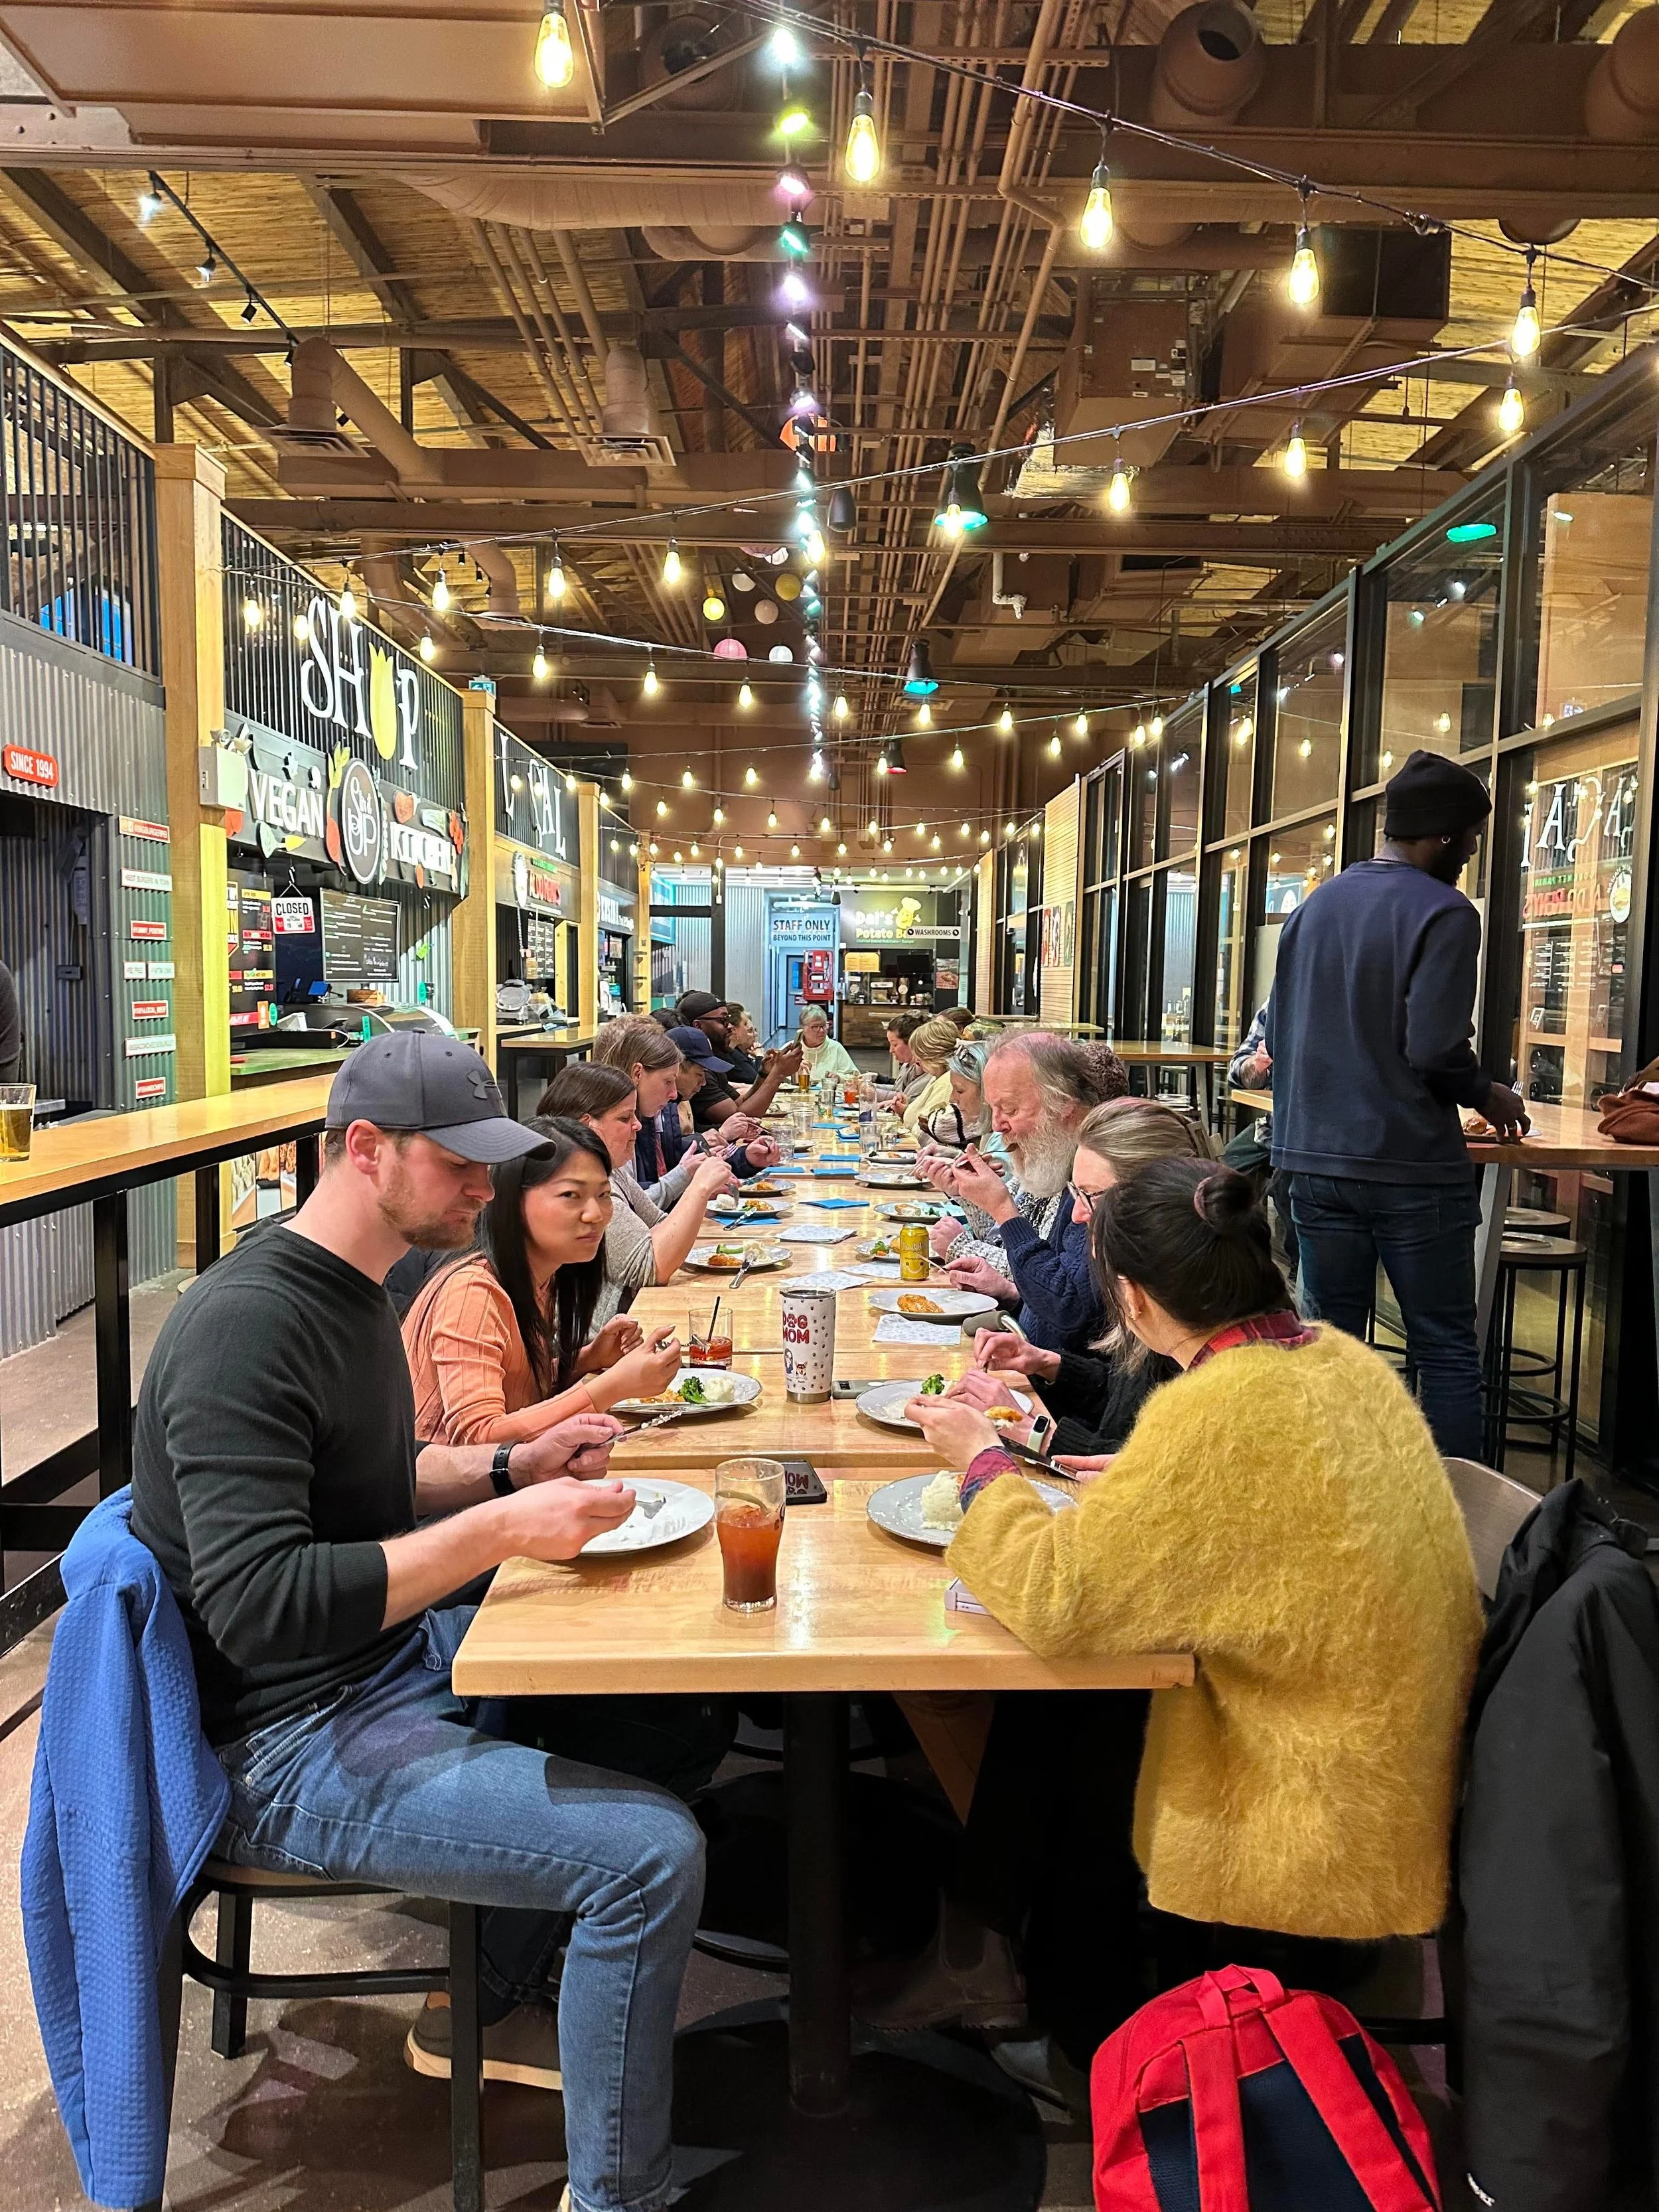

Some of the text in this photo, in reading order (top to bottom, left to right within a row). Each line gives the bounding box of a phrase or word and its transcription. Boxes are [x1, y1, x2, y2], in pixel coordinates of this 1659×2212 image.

[11, 751, 54, 780] SINCE 1994
[248, 769, 451, 875] VEGAN KITCHEN
[276, 903, 309, 915] CLOSED
[774, 920, 830, 930] STAFF ONLY
[855, 928, 894, 939] Potato
